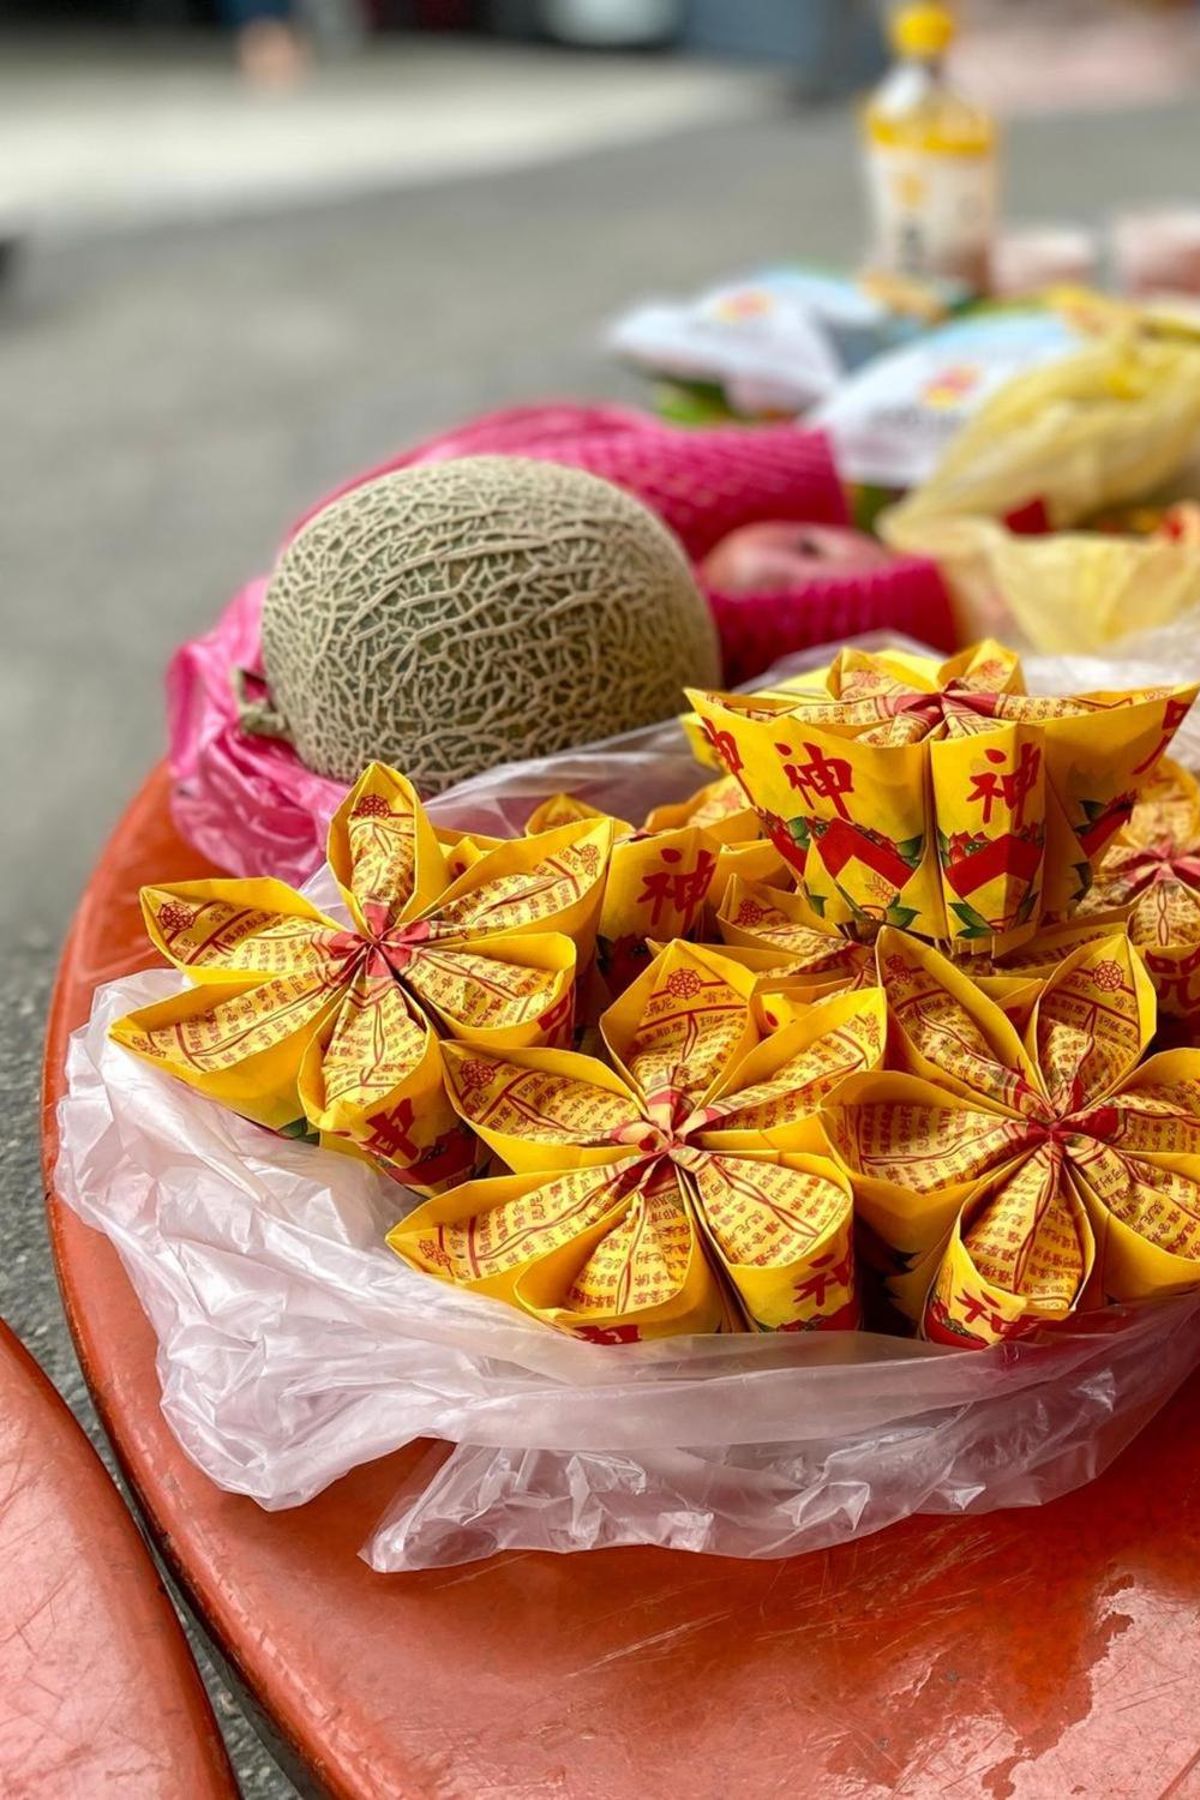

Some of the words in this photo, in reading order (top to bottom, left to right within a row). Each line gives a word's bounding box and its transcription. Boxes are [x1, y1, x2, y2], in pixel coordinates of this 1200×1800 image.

[774, 741, 855, 821] 神
[966, 741, 1042, 831] 神
[636, 847, 717, 937] 神
